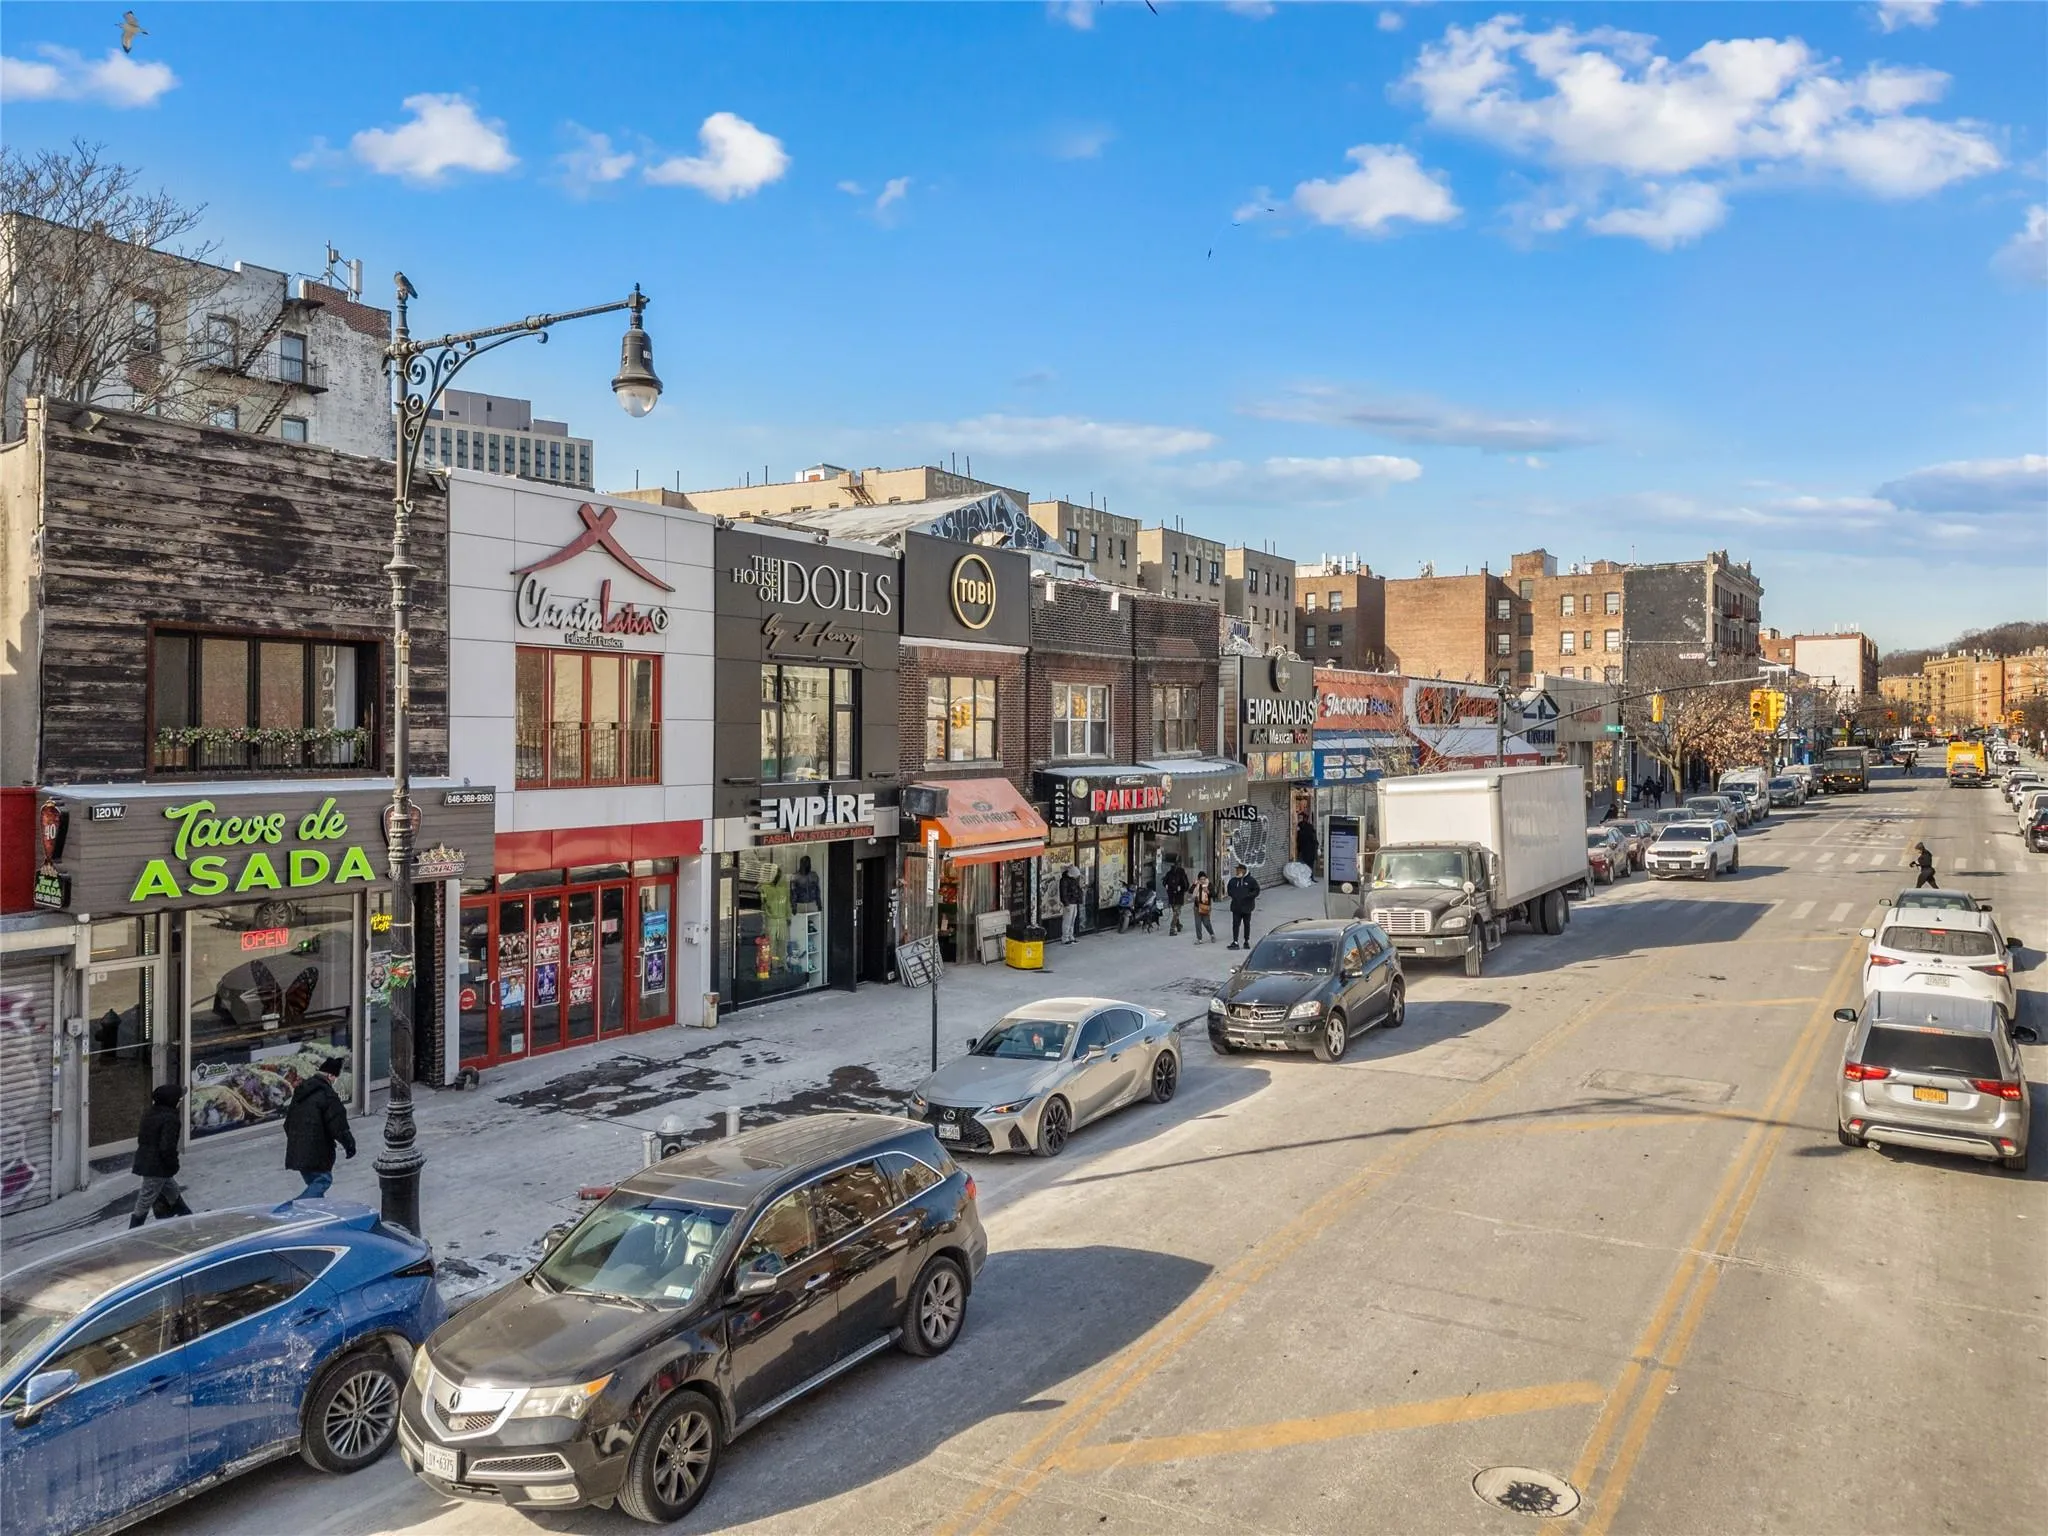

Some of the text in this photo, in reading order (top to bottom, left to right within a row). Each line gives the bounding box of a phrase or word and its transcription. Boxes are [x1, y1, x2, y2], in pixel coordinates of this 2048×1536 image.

[751, 555, 778, 573] THE
[734, 568, 778, 587] HOUSE
[782, 559, 891, 616] DOLLS
[759, 587, 778, 602] OF
[960, 578, 991, 605] TOBI
[565, 633, 624, 648] Hibachi Fusion
[763, 612, 789, 650] by
[796, 620, 864, 655] Henry
[1248, 698, 1314, 725] EMPANADAS
[1326, 693, 1369, 717] JACKPOT
[1269, 728, 1293, 744] Mexican
[1055, 784, 1065, 827] BAKERY
[1092, 787, 1165, 812] BAKERY
[95, 807, 124, 818] 120 W.
[759, 785, 875, 838] EMPIRE
[1218, 806, 1256, 820] NAILS
[44, 823, 56, 840] 40
[165, 798, 348, 860] Tacos de
[762, 827, 872, 845] FASHION STATE OF MIND
[1138, 819, 1178, 834] NAILS
[130, 847, 376, 902] ASADA
[244, 929, 287, 948] OPEN
